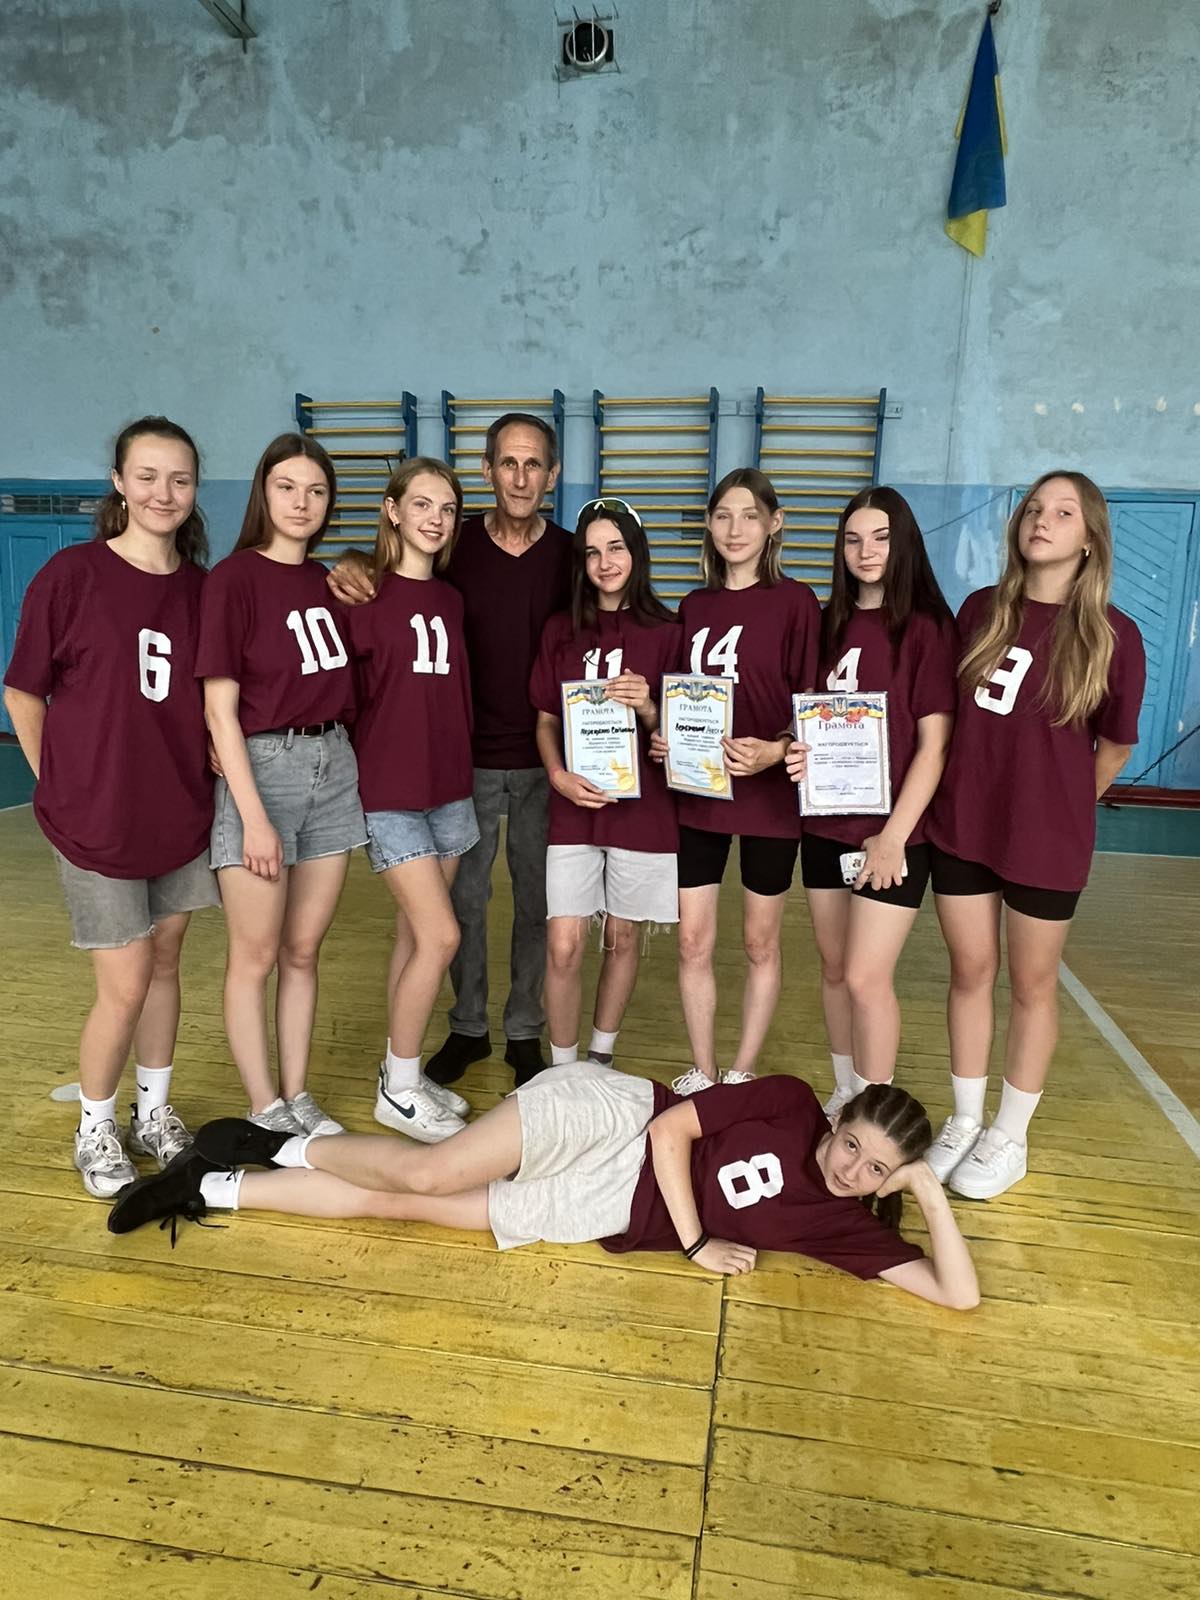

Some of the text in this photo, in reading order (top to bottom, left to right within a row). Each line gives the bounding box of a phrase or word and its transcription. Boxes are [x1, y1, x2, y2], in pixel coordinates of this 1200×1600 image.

[139, 629, 171, 703] 6
[287, 607, 348, 675] 10
[410, 613, 450, 675] 11
[583, 648, 623, 680] 11
[690, 626, 744, 684] 14
[826, 648, 862, 693] 4
[582, 708, 615, 716] ГРАМОТА
[679, 704, 712, 713] ГРАМОТА
[818, 720, 865, 731] Грамота
[718, 1153, 784, 1210] 8
